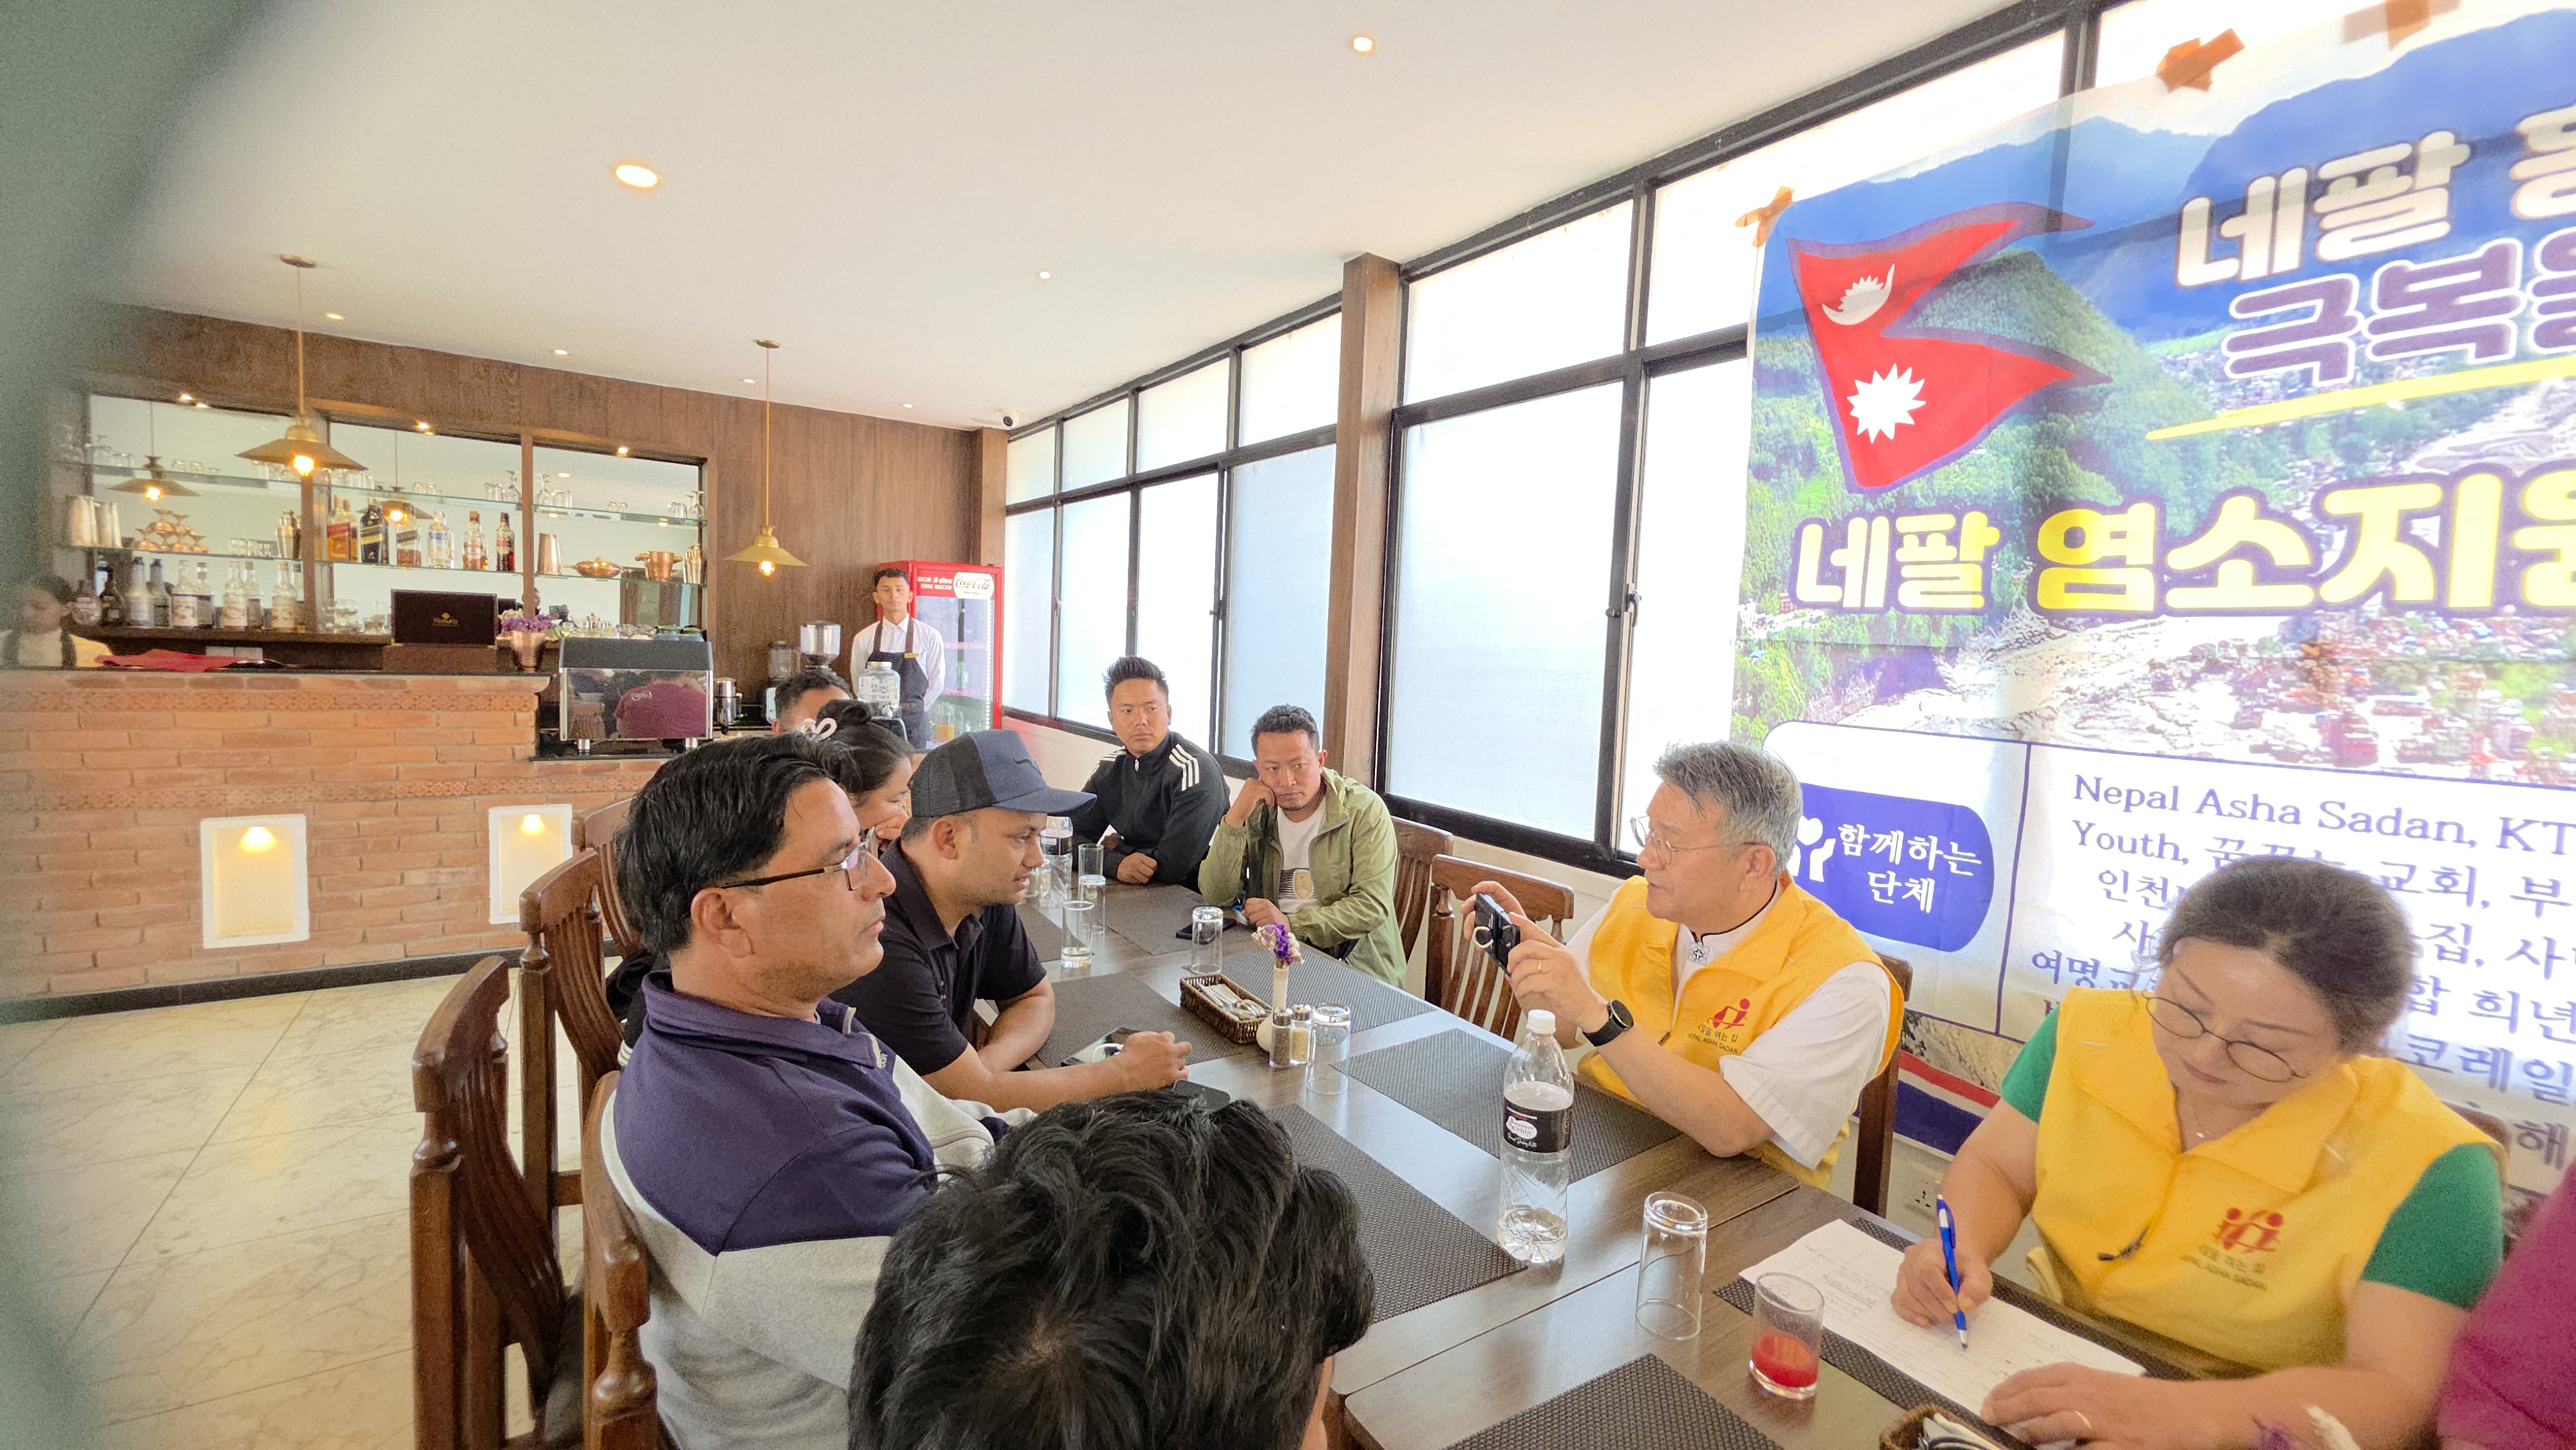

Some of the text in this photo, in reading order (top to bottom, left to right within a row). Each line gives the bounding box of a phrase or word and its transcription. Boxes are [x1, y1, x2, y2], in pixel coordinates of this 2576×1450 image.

[2175, 130, 2472, 288] 네팔
[1794, 509, 2001, 610] 네팔
[2073, 774, 2180, 813] Nepal
[2193, 788, 2302, 825] Asha
[2318, 800, 2478, 849] Sadan,
[1837, 823, 1982, 876] 함께하는
[2072, 819, 2190, 866] Youth,
[2378, 861, 2491, 909] 교회,
[1867, 870, 1936, 914] 단체
[2098, 869, 2189, 911] 인천
[2467, 990, 2576, 1046] 희년
